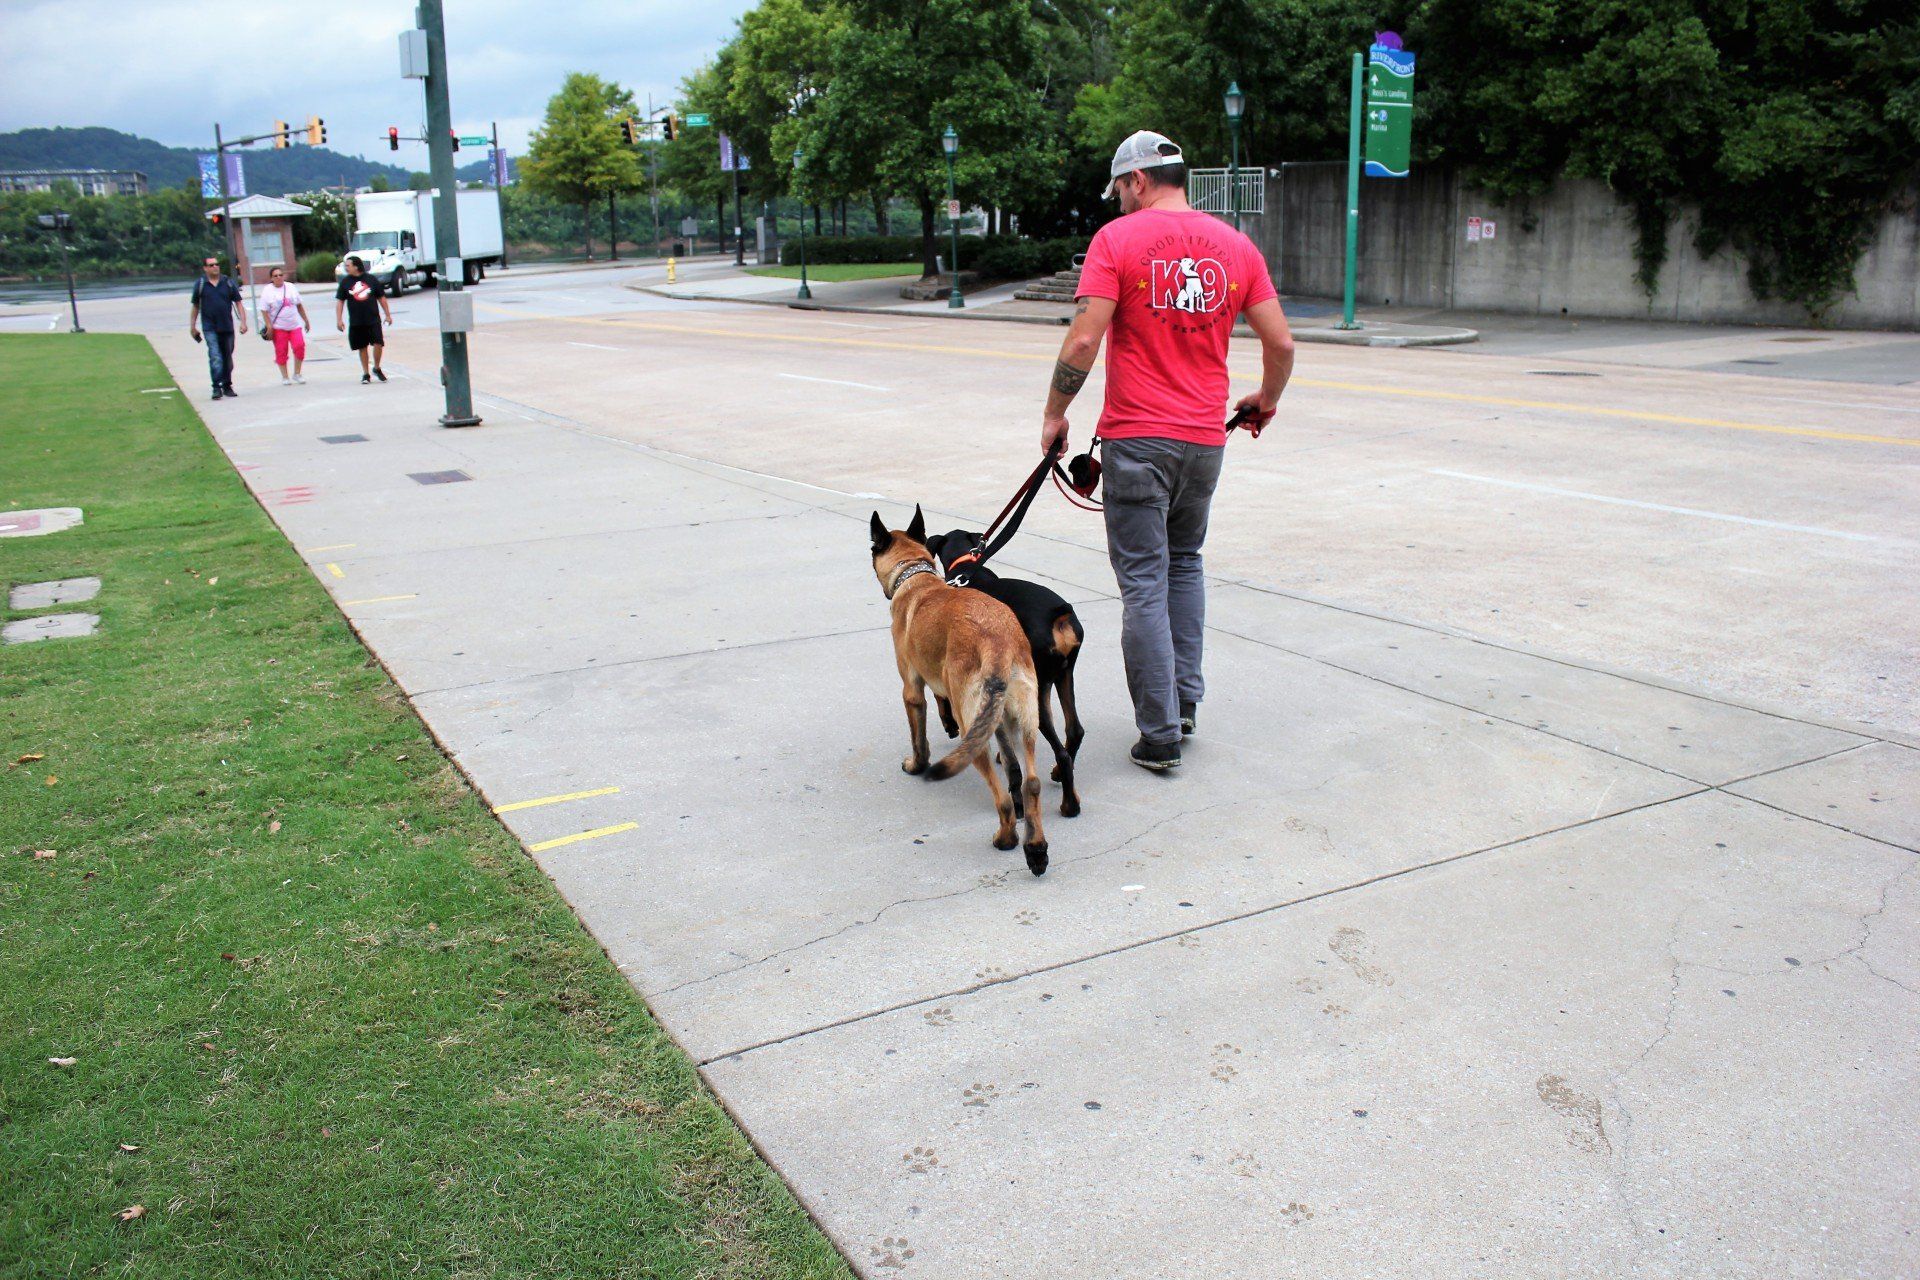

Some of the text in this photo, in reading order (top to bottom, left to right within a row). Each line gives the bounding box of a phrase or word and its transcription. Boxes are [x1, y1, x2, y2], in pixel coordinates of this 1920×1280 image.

[1371, 51, 1415, 73] RIVERFRONT
[1140, 234, 1233, 267] GOOD CITIZEN
